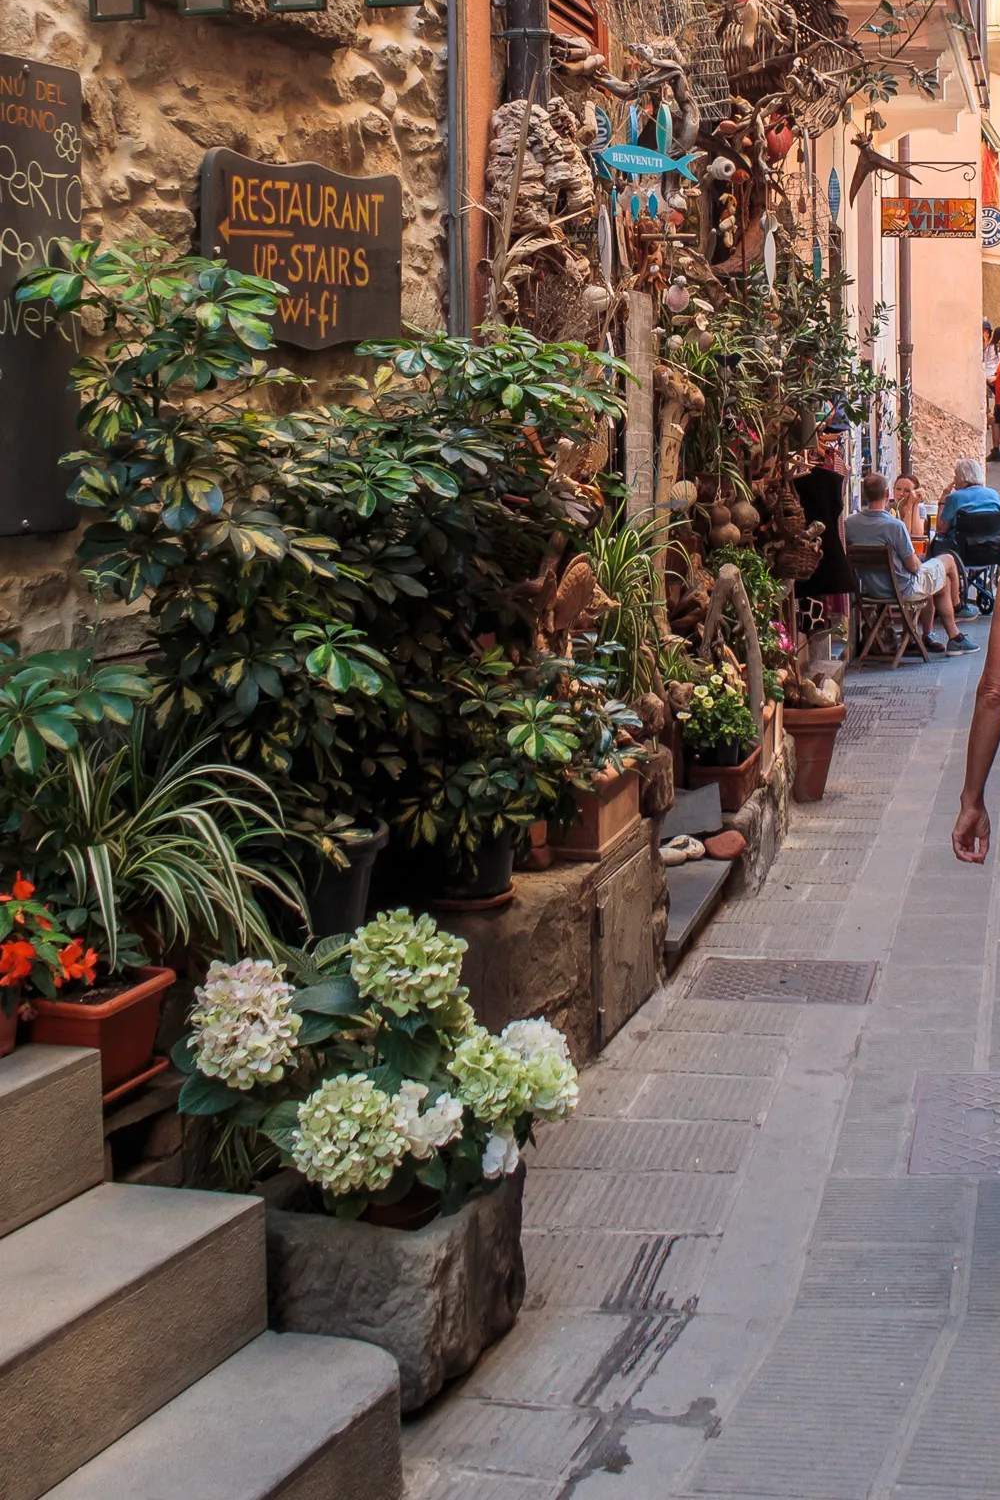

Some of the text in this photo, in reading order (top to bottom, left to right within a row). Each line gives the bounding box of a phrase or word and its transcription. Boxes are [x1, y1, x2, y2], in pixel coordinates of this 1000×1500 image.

[0, 70, 68, 106] NÚ DEL
[0, 102, 56, 133] IORNO
[612, 152, 663, 168] BENVENUTI
[231, 175, 385, 237] RESTAURANT
[908, 214, 949, 229] VIN
[910, 200, 949, 215] PAN
[254, 243, 371, 287] UP-STAIRS
